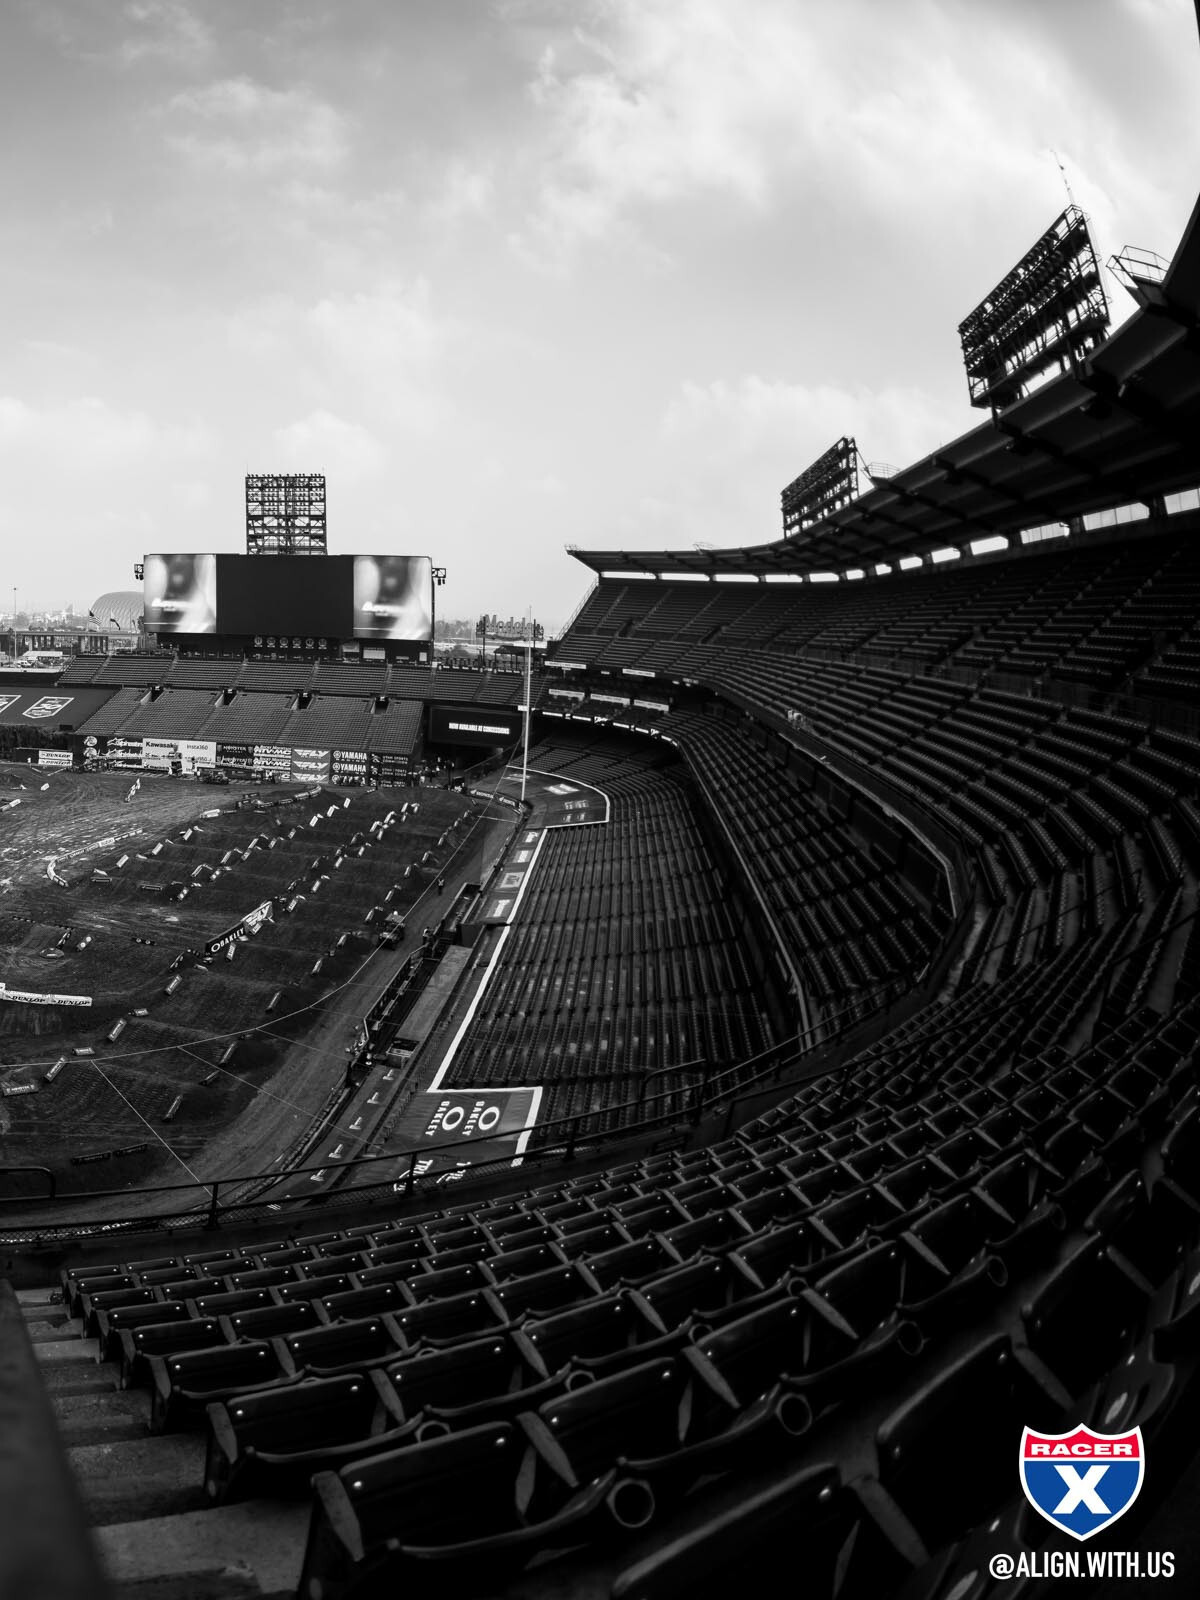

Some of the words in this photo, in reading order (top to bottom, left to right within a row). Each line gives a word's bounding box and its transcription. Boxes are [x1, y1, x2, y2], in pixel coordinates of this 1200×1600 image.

[341, 751, 367, 760] YAMAHA
[340, 763, 366, 772] YAMAHA
[220, 927, 244, 947] OAKLEY
[11, 995, 46, 1003] DUNLOP
[425, 1100, 451, 1136] OAKLEY
[462, 1100, 486, 1136] OAKLEY
